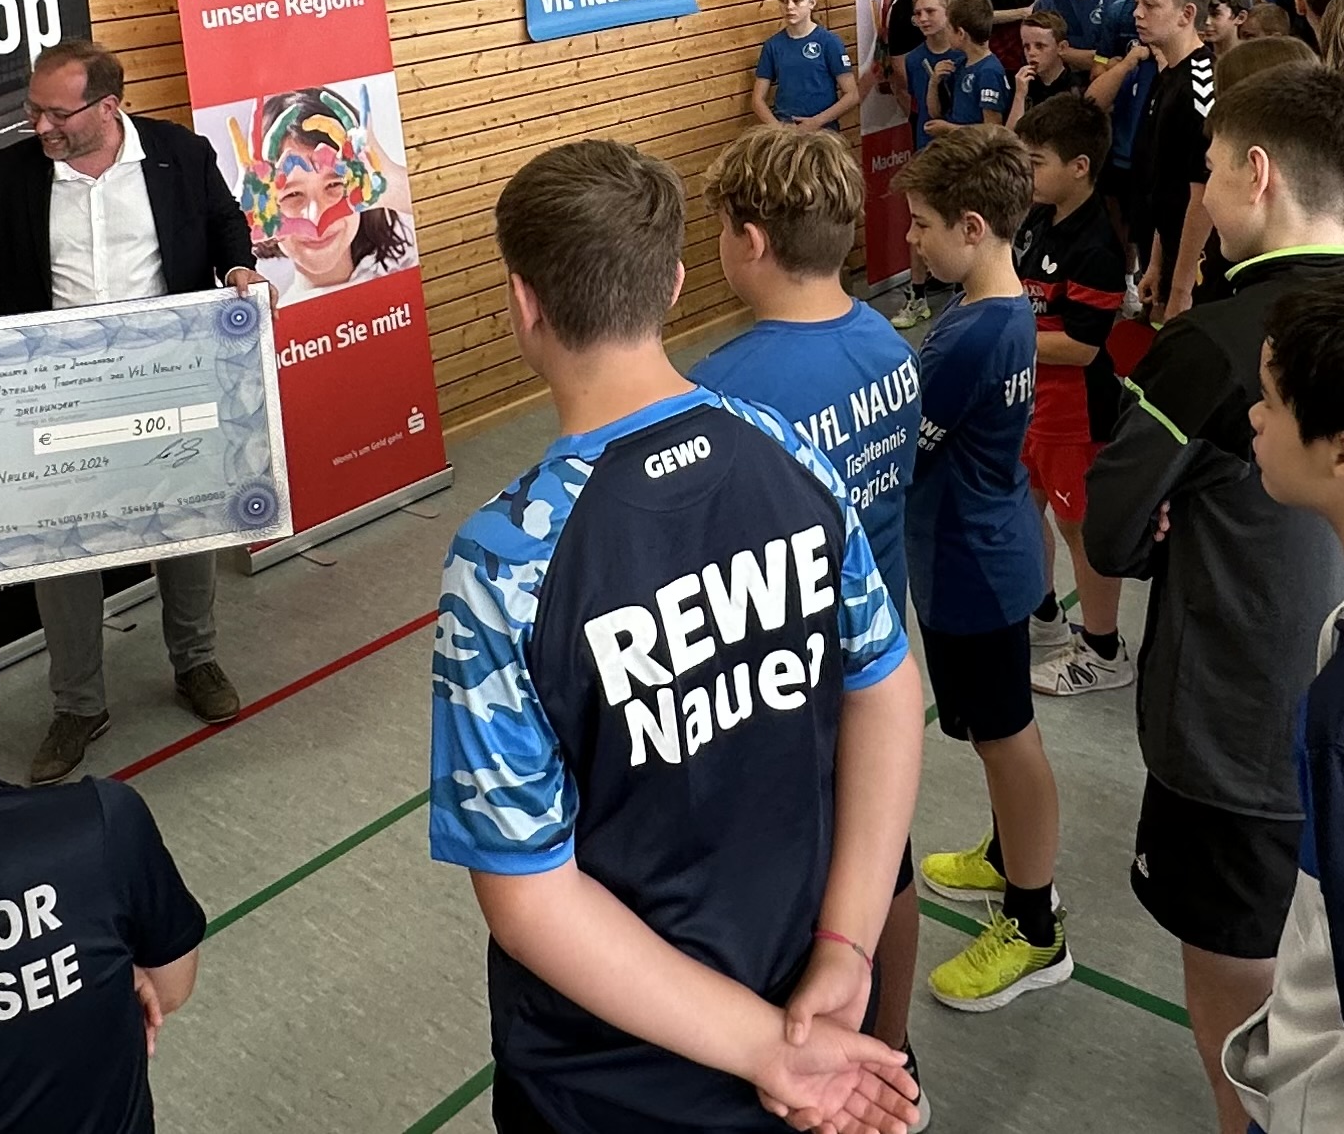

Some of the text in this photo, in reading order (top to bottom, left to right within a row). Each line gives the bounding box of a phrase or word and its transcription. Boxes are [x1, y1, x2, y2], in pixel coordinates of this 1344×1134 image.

[201, 0, 280, 29] unsere
[871, 148, 912, 173] Machen
[276, 303, 412, 370] chen Sie mit!
[794, 405, 850, 451] VfL
[919, 416, 947, 442] WE
[43, 456, 110, 477] 23.06.2024
[644, 435, 712, 479] GEWO
[845, 425, 907, 479] Tischtennis
[850, 462, 900, 511] Patrick
[584, 524, 835, 707] REWE
